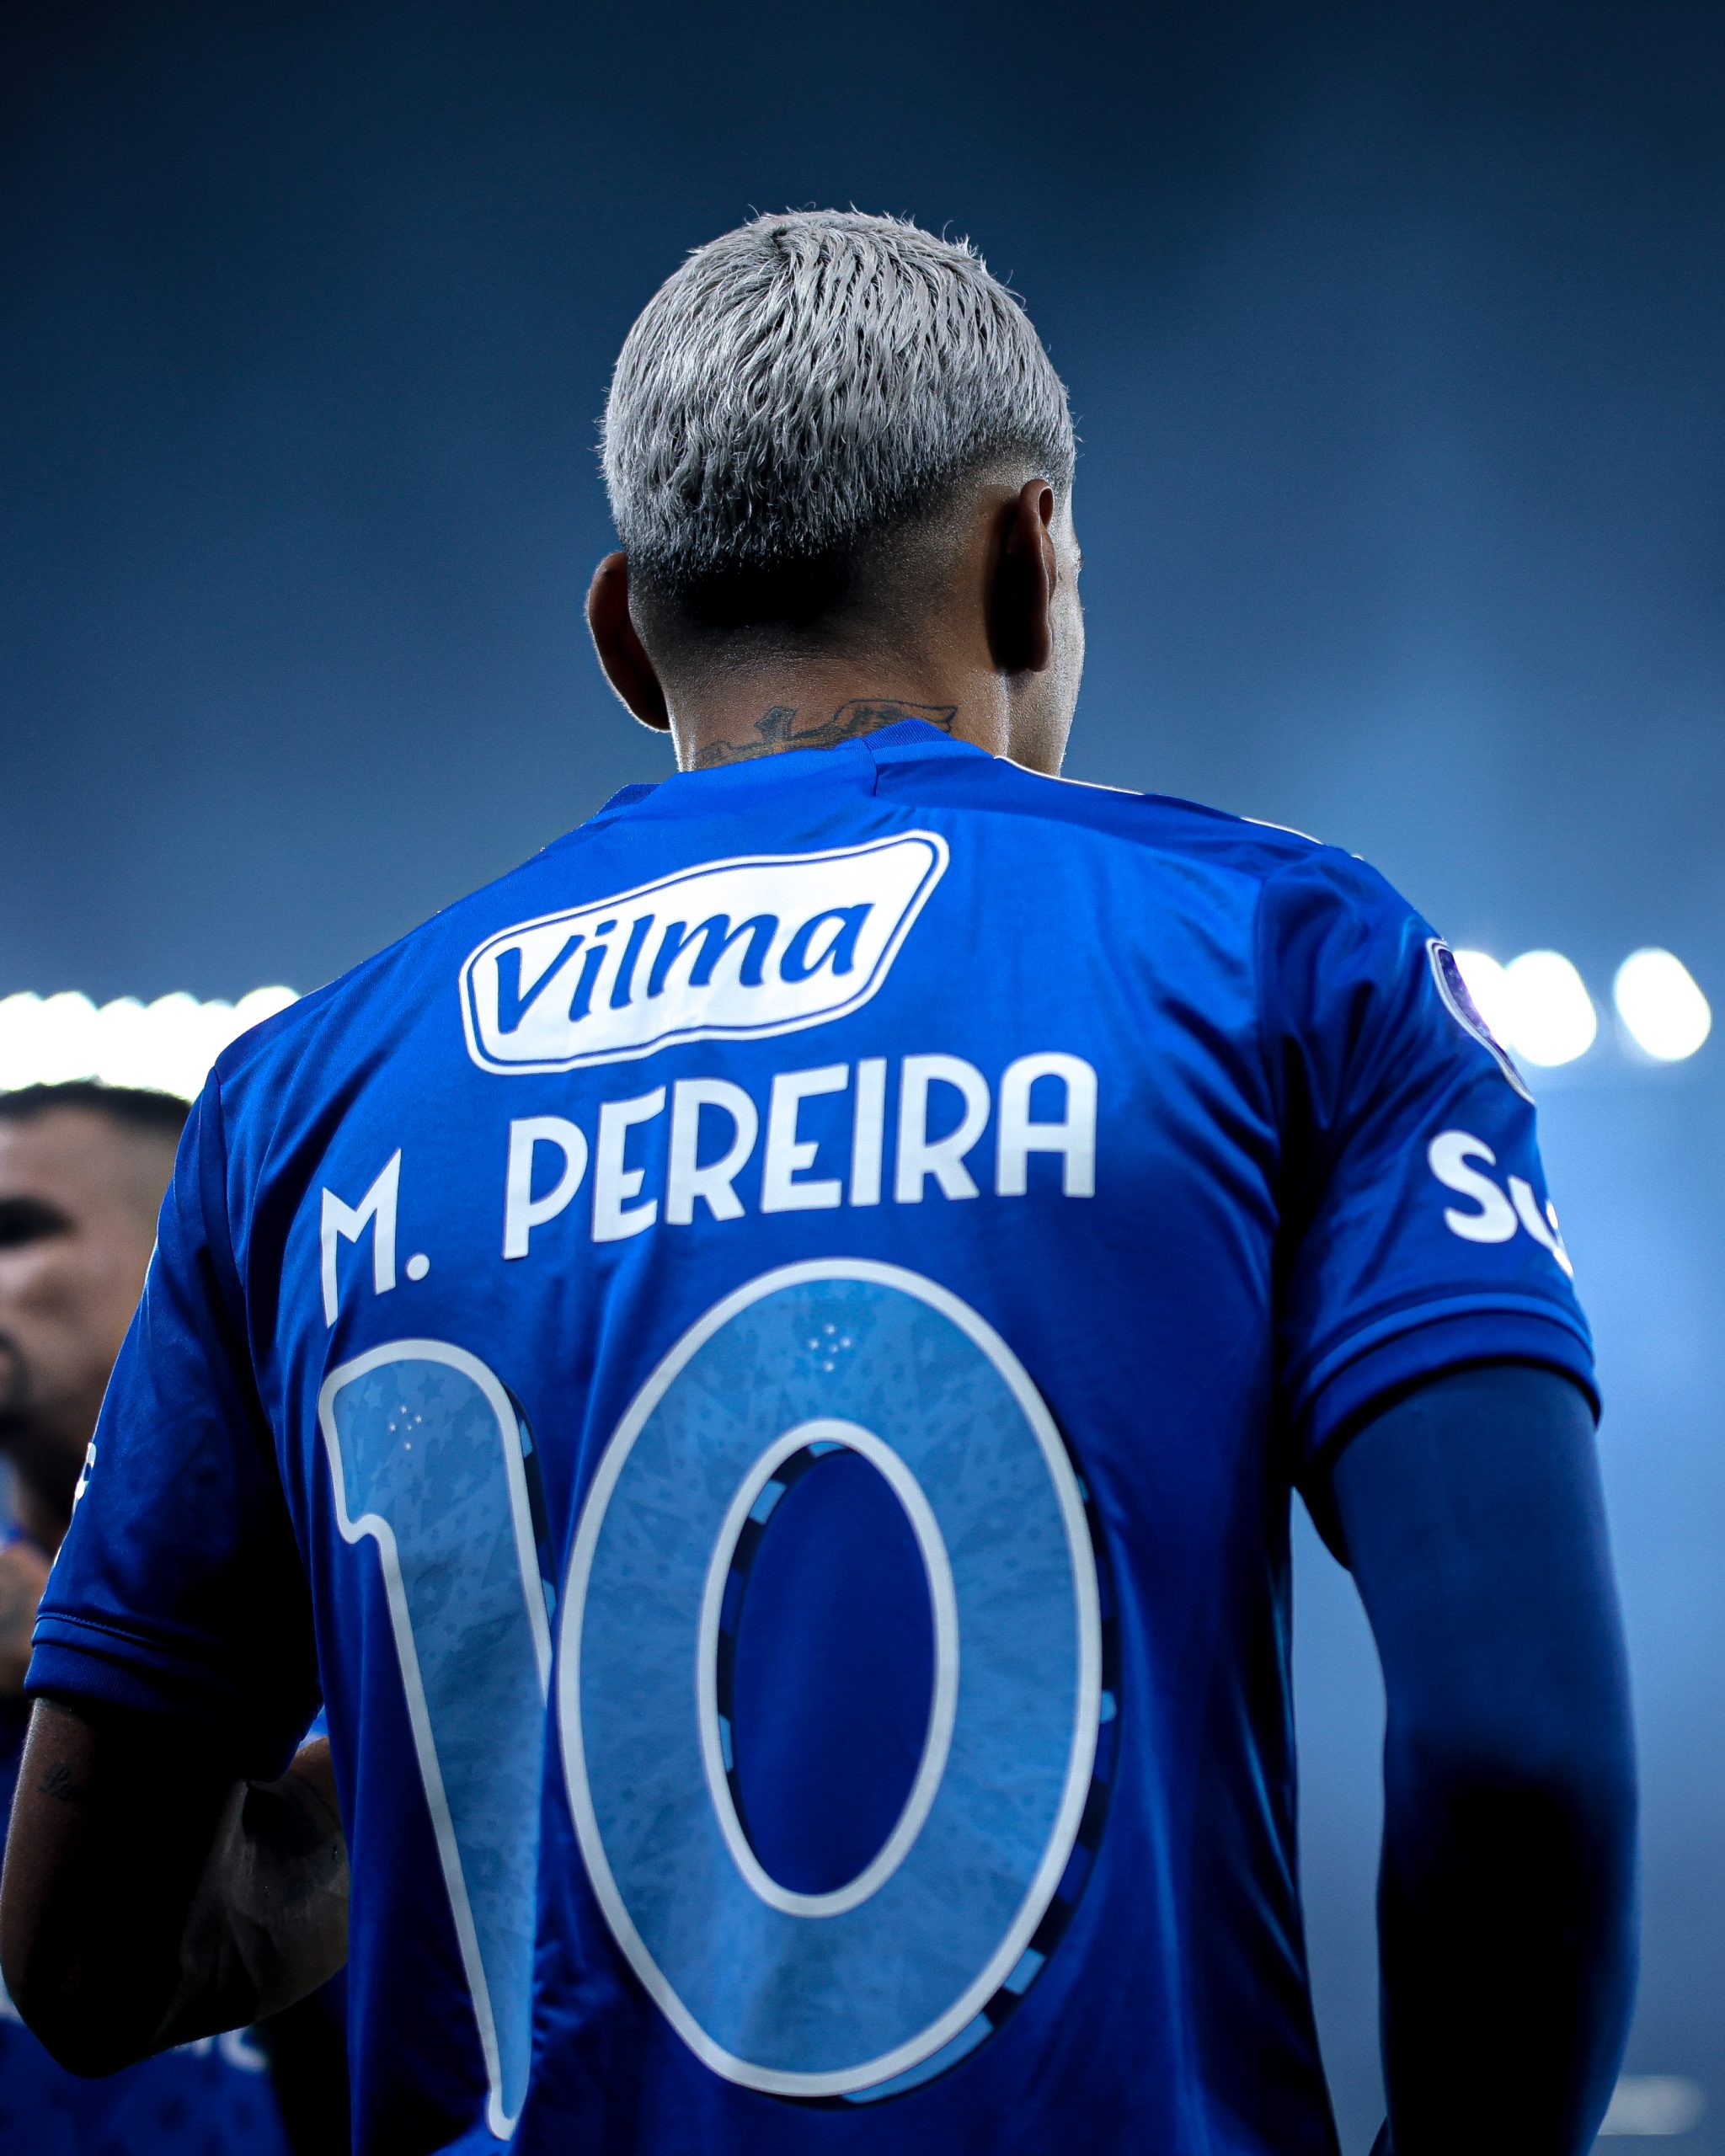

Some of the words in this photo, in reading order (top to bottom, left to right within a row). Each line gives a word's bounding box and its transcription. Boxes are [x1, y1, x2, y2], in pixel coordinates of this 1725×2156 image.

[495, 902, 876, 1034] Vilma
[320, 1147, 430, 1329] M.
[503, 1052, 1098, 1260] PEREIRA
[318, 1257, 1107, 2141] 10
